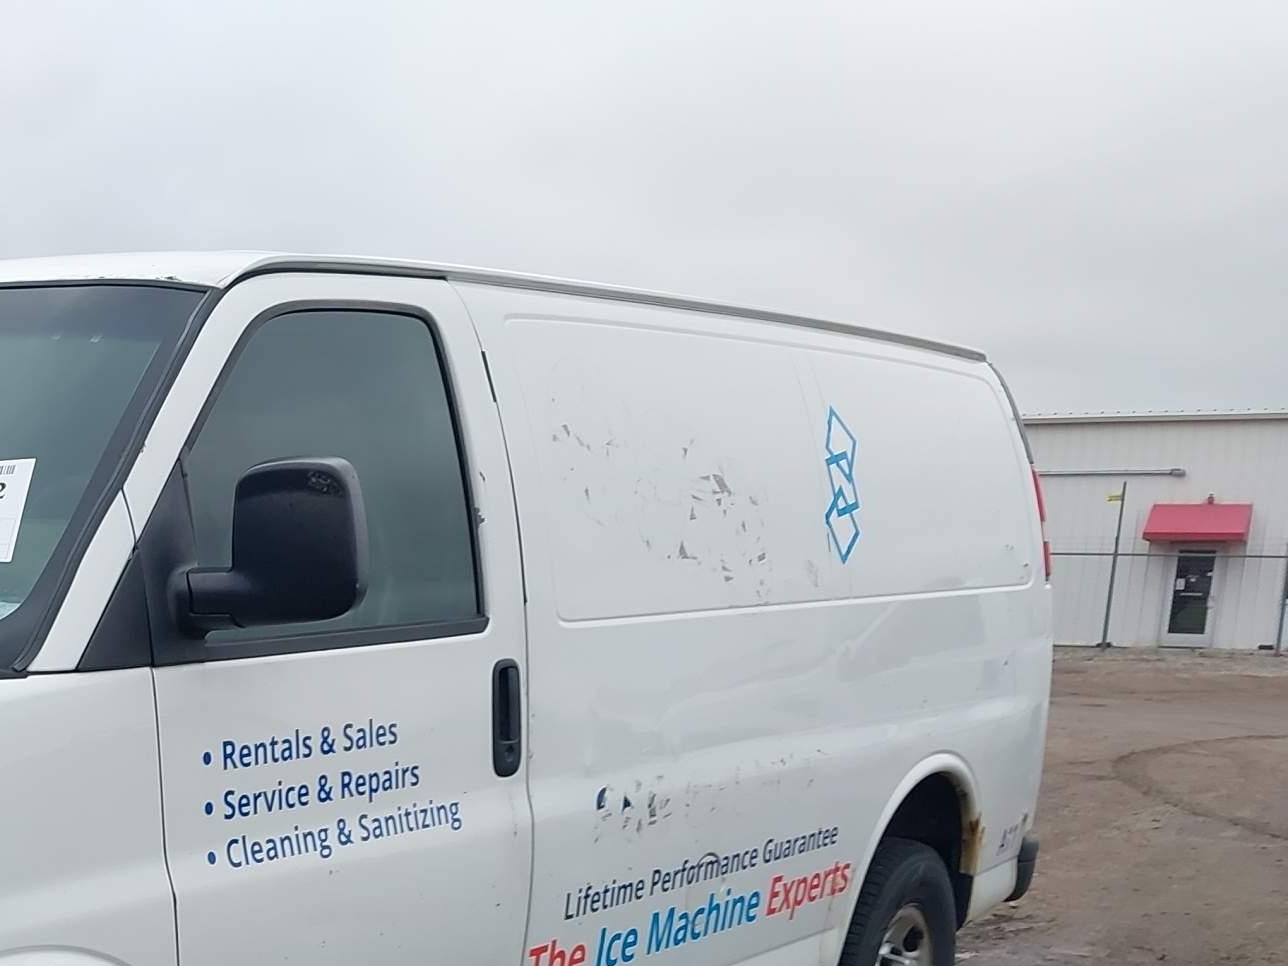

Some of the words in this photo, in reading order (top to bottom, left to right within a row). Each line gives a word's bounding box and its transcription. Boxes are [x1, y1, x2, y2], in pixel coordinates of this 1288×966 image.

[222, 729, 313, 770] Rentals
[319, 726, 337, 756] &
[342, 718, 399, 752] Sales
[223, 780, 310, 820] Service
[317, 774, 334, 804] &
[340, 761, 420, 804] Repairs
[226, 825, 333, 868] Cleaning
[336, 818, 354, 846] &
[358, 799, 463, 842] Sanitizing
[563, 879, 645, 921] Lifetime
[649, 847, 759, 897] Performance
[762, 825, 840, 864] Guarantee
[645, 887, 761, 956] Machine
[765, 861, 851, 921] Experts
